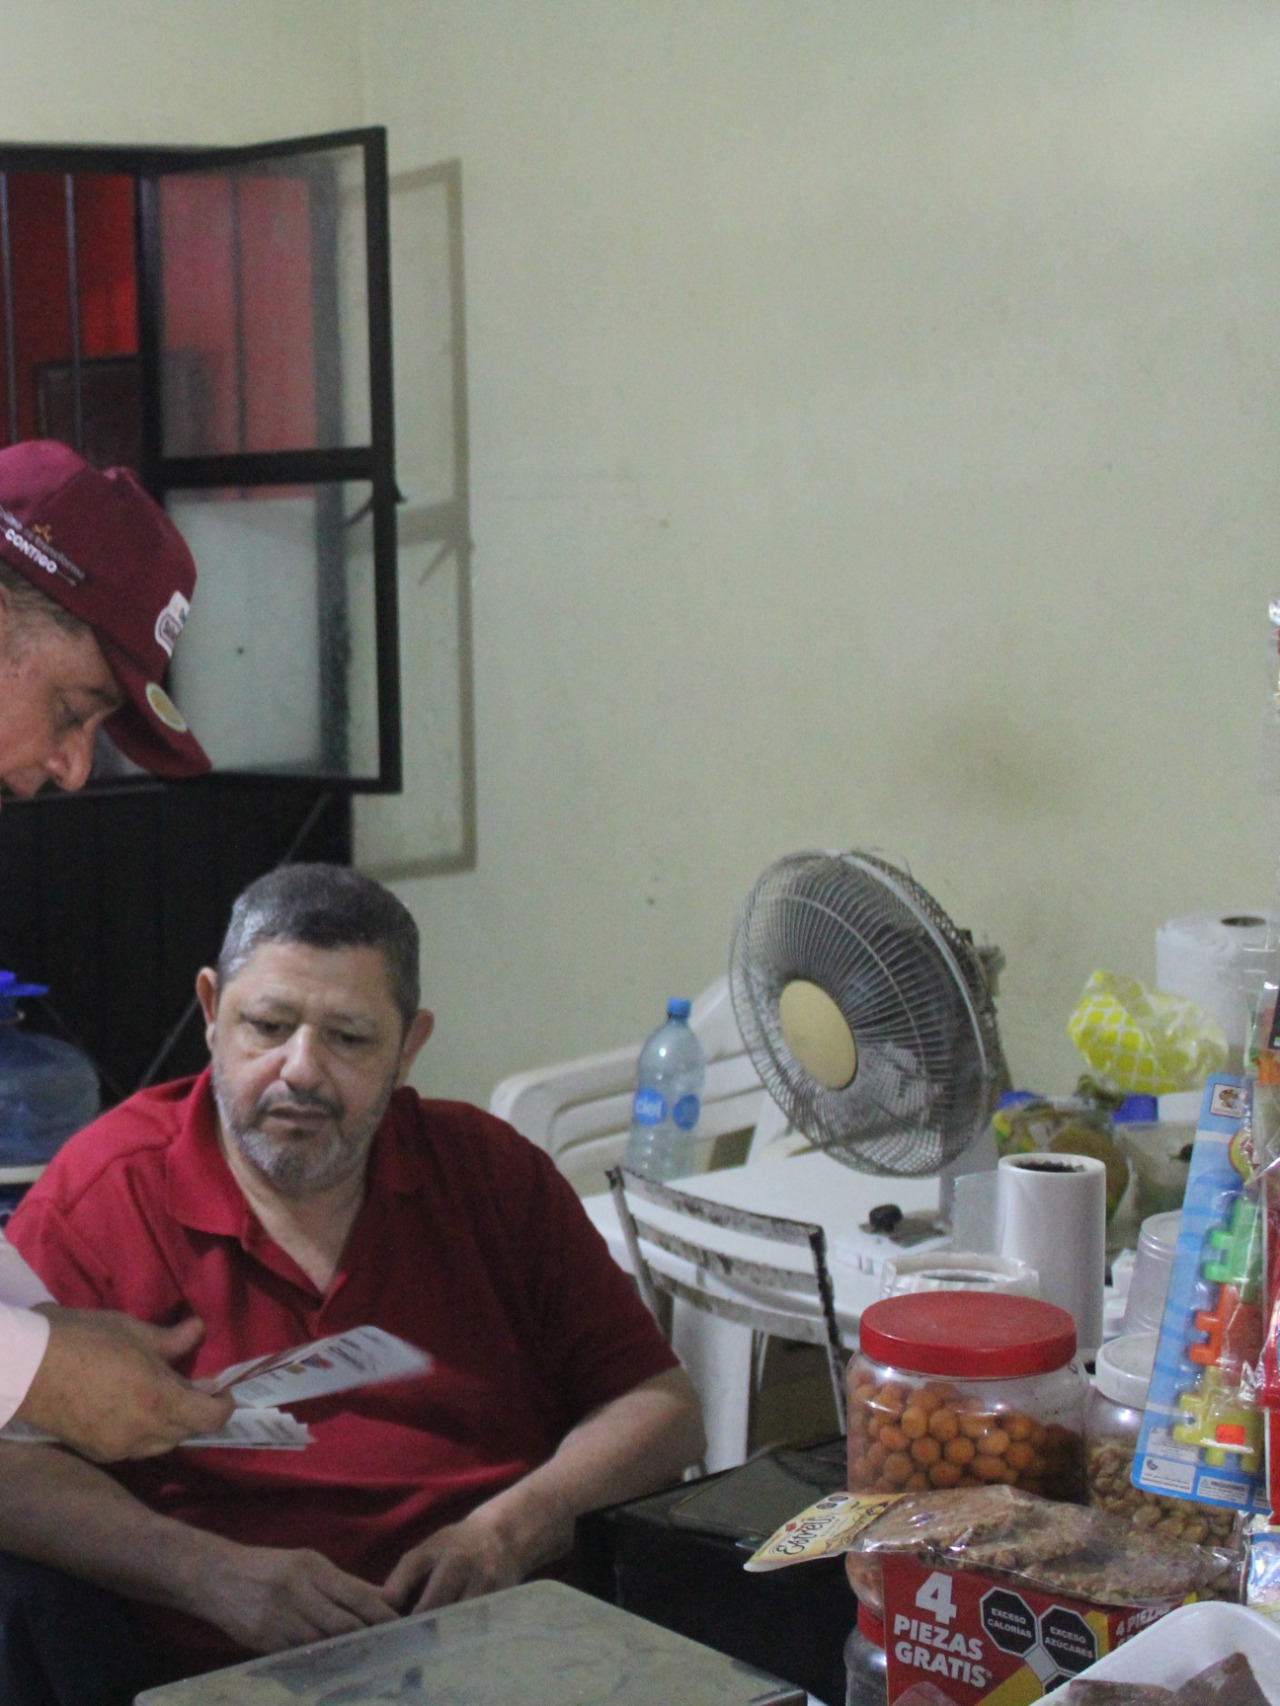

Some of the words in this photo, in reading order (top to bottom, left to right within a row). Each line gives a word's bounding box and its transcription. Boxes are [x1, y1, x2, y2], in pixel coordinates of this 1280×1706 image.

[5, 528, 58, 574] CONTIGO
[915, 1571, 957, 1625] 4
[991, 1607, 1027, 1625] EXCESO
[893, 1613, 983, 1661] PIEZAS
[1049, 1626, 1087, 1644] EXCESO
